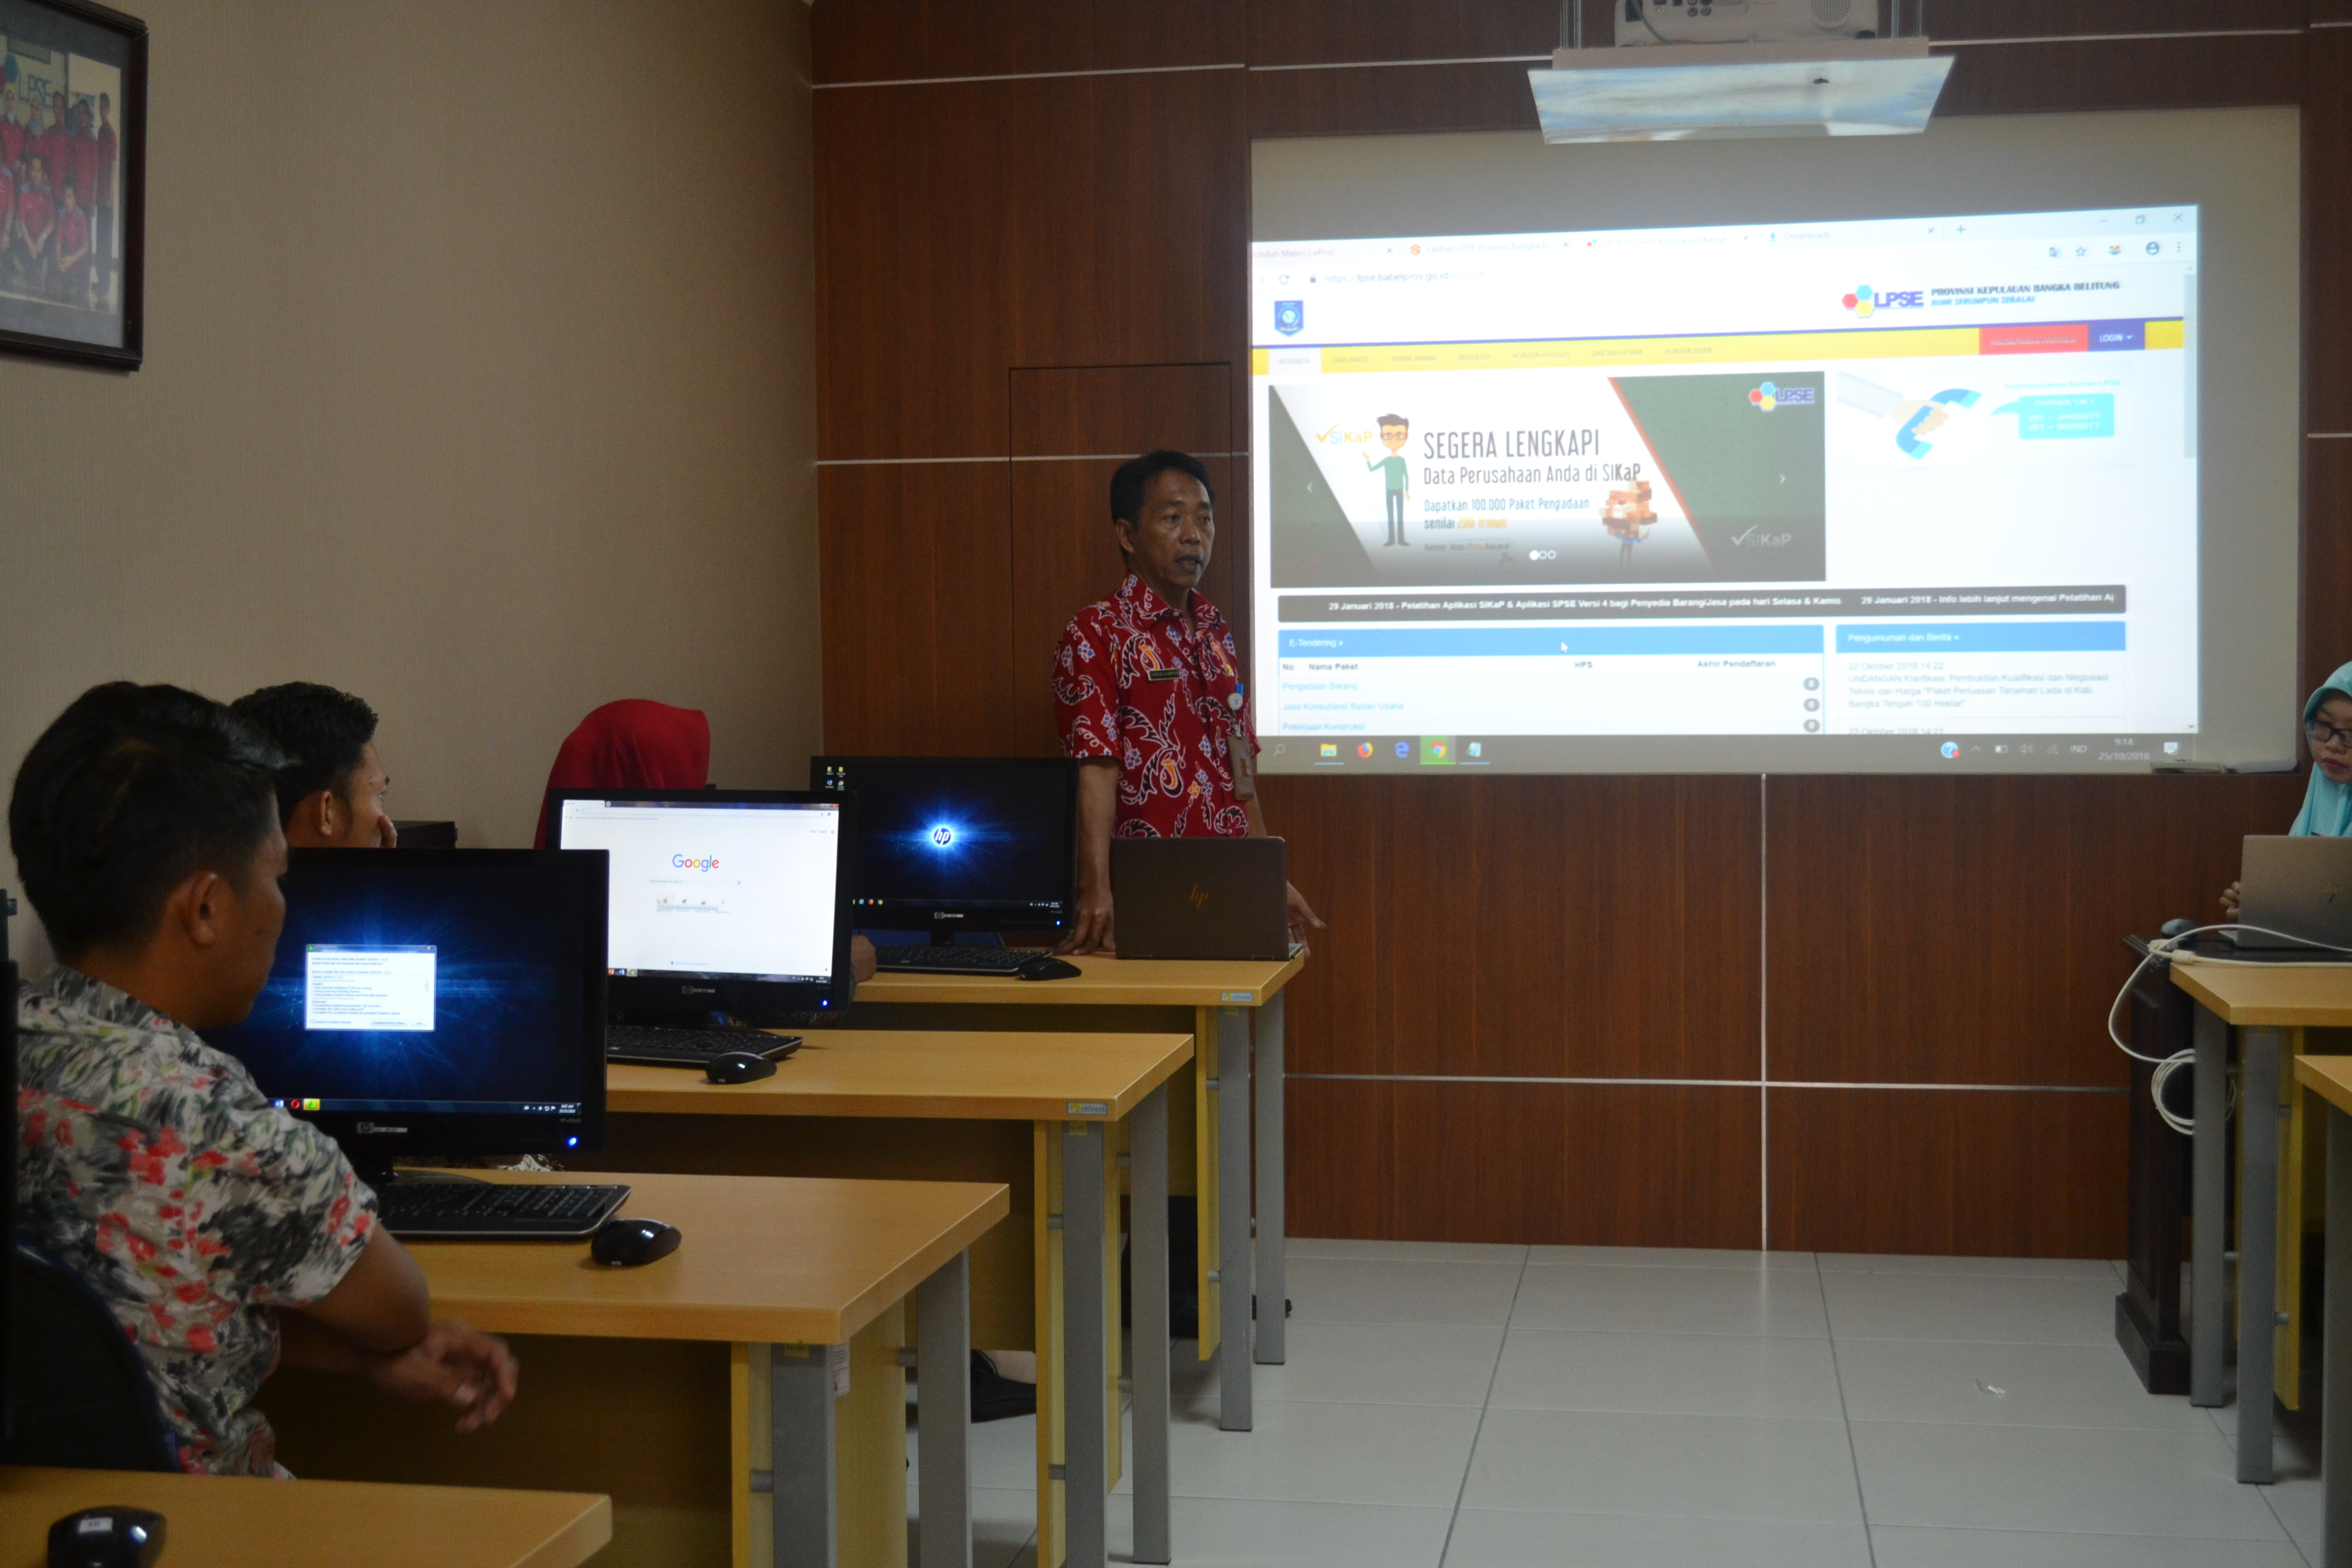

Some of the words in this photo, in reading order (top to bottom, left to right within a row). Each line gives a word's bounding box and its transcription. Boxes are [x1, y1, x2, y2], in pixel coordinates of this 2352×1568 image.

[1784, 231, 1831, 240] Downloads
[1279, 249, 1307, 257] Materi
[1427, 244, 1456, 254] Latihan
[1458, 243, 1476, 252] LPSE
[1478, 243, 1509, 251] Provinsi
[1931, 287, 1974, 296] PROVINSI
[1977, 285, 2031, 295] KEPULAUAN
[2033, 283, 2071, 292] BANGKA
[2074, 281, 2120, 291] BELITUNG
[1874, 291, 1923, 307] LPSE
[2099, 334, 2122, 342] LOGIN
[1775, 389, 1814, 402] LPSE
[1424, 431, 1497, 459] SEGERA
[1506, 429, 1599, 458] LENGKAPI
[1424, 467, 1455, 485] Data
[1461, 466, 1540, 483] Perusahaan
[1547, 465, 1580, 482] Anda
[1586, 464, 1597, 481] di
[1425, 500, 1468, 513] Dapatkan
[1472, 499, 1505, 511] 100.000
[1509, 498, 1535, 510] Paket
[1538, 498, 1589, 512] Pengadaan
[1424, 517, 1455, 529] senilai
[1458, 517, 1475, 529] 200
[1329, 602, 1339, 610] 29
[1341, 602, 1372, 610] Januari
[1374, 601, 1394, 610] 2018
[1401, 601, 1440, 609] Pelatihan
[1442, 600, 1477, 611] Aplikasi
[1515, 600, 1550, 610] Aplikasi
[1610, 599, 1628, 608] bagi
[1630, 598, 1671, 608] Penyedia
[1673, 598, 1727, 608] Barang/Jasa
[1729, 598, 1751, 607] pada
[1813, 597, 1841, 605] Kamis
[1874, 596, 1908, 604] Januari
[1910, 596, 1931, 604] 2018
[1939, 595, 1957, 603] Info
[1959, 595, 1981, 603] lebih
[1984, 594, 2009, 605] lanjut
[2012, 594, 2057, 604] mengenai
[2059, 594, 2101, 602] Pelatihan
[1848, 633, 1906, 643] Pengumuman
[1289, 639, 1336, 649] E-Tendering
[1861, 662, 1894, 670] Oktober
[1848, 674, 1902, 682] UNDANGAN
[1950, 674, 2000, 682] Pembuktian
[2002, 673, 2045, 681] Kualifikasi
[2047, 673, 2064, 681] dan
[2066, 673, 2109, 683] Negosiasi
[1283, 682, 1327, 692] Pengadaan
[1329, 682, 1358, 692] Barang
[1896, 687, 1921, 697] Harga
[1954, 687, 1996, 695] Perluasan
[1999, 686, 2038, 694] Tanaman
[2040, 686, 2062, 694] Lada
[2074, 686, 2094, 694] Kab.
[1283, 702, 1301, 710] Jasa
[1351, 702, 1376, 710] Badan
[1378, 701, 1404, 710] Usaha
[1848, 700, 1880, 709] Bangka
[1883, 699, 1914, 709] Tengah
[1916, 699, 1931, 707] 100
[1283, 722, 1322, 732] Pekerjaan
[1324, 722, 1365, 730] Konstruksi
[2098, 752, 2150, 761] 25/10/2018
[935, 826, 950, 846] hp
[672, 853, 719, 872] Google
[1190, 885, 1210, 909] hp
